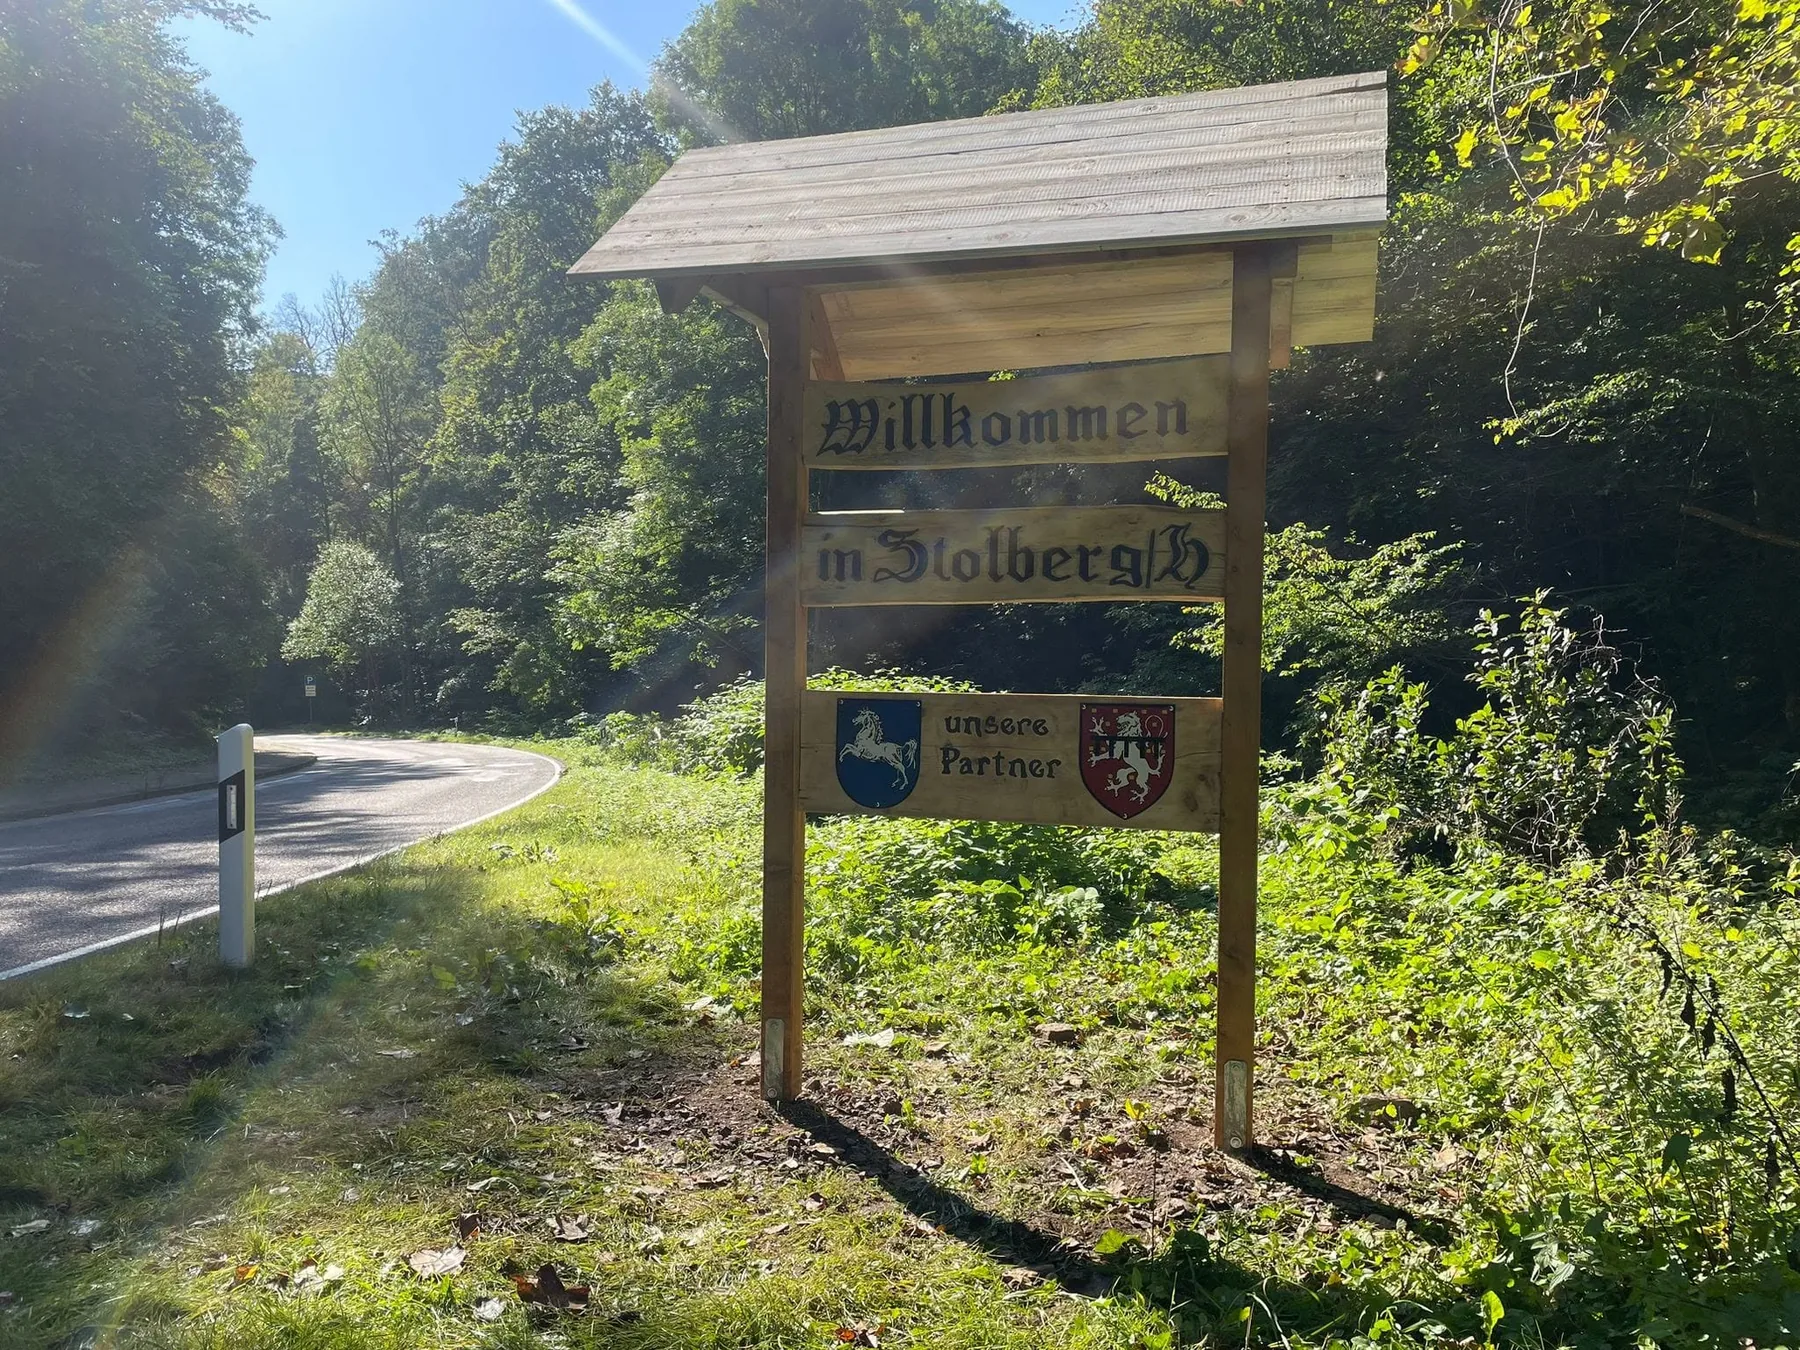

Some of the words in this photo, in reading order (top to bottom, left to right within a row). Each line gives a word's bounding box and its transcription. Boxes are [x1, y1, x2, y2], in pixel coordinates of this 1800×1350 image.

[816, 391, 1190, 457] Willkommen
[817, 532, 864, 582] in
[306, 676, 314, 685] P
[943, 713, 1050, 738] unsere
[939, 743, 1063, 780] Partner
